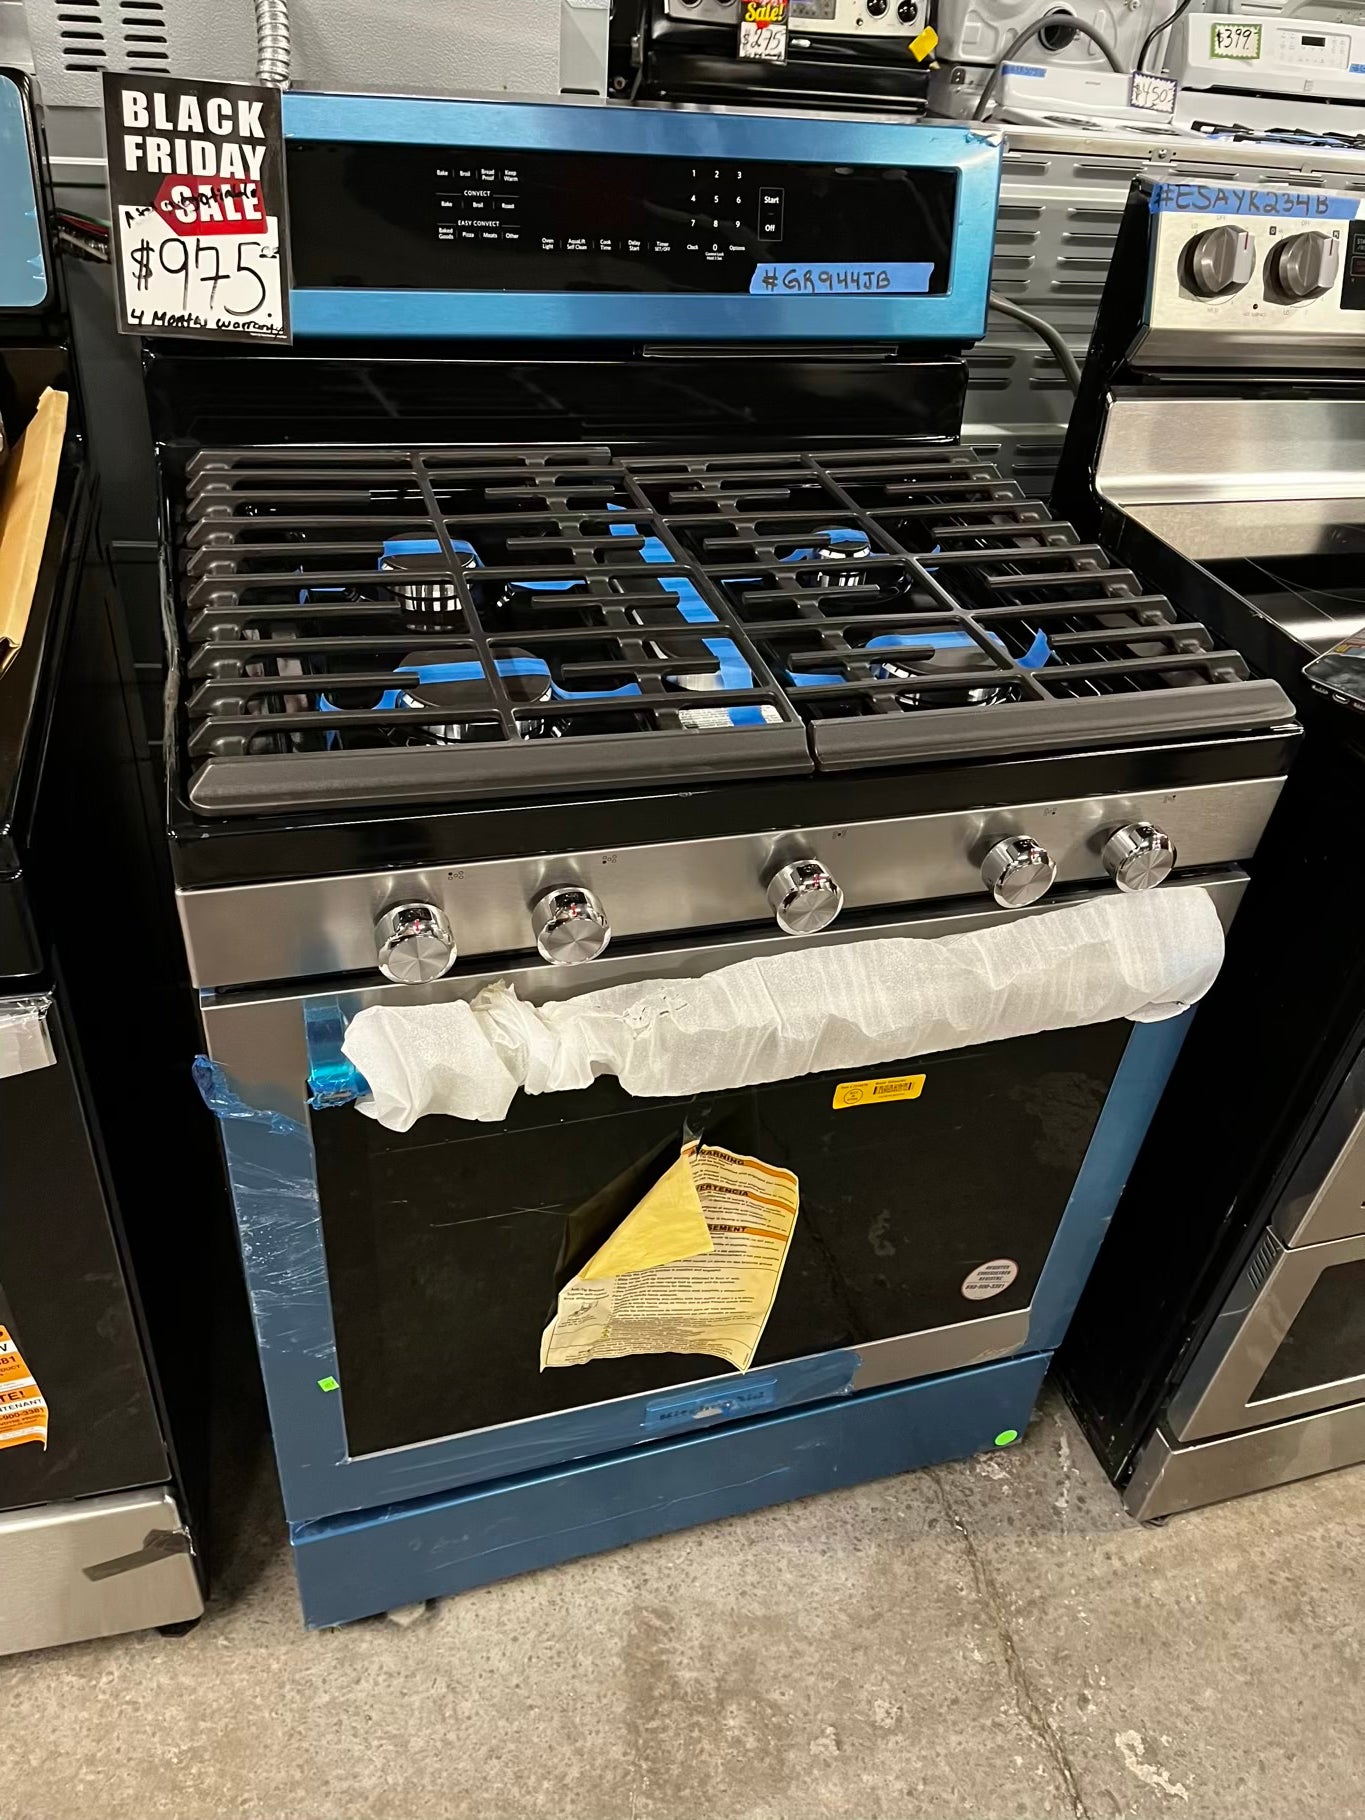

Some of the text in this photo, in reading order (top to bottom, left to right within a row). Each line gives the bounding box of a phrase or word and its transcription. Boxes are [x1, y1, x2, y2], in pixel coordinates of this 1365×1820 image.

[745, 1, 785, 22] Sale!
[121, 90, 265, 138] BLACK
[124, 135, 266, 181] FRIDAY
[714, 170, 719, 178] 2
[737, 171, 742, 179] 3
[171, 184, 263, 224] SALE
[714, 195, 719, 203] 5
[762, 266, 890, 292] #GR944JB
[130, 308, 144, 326] 4
